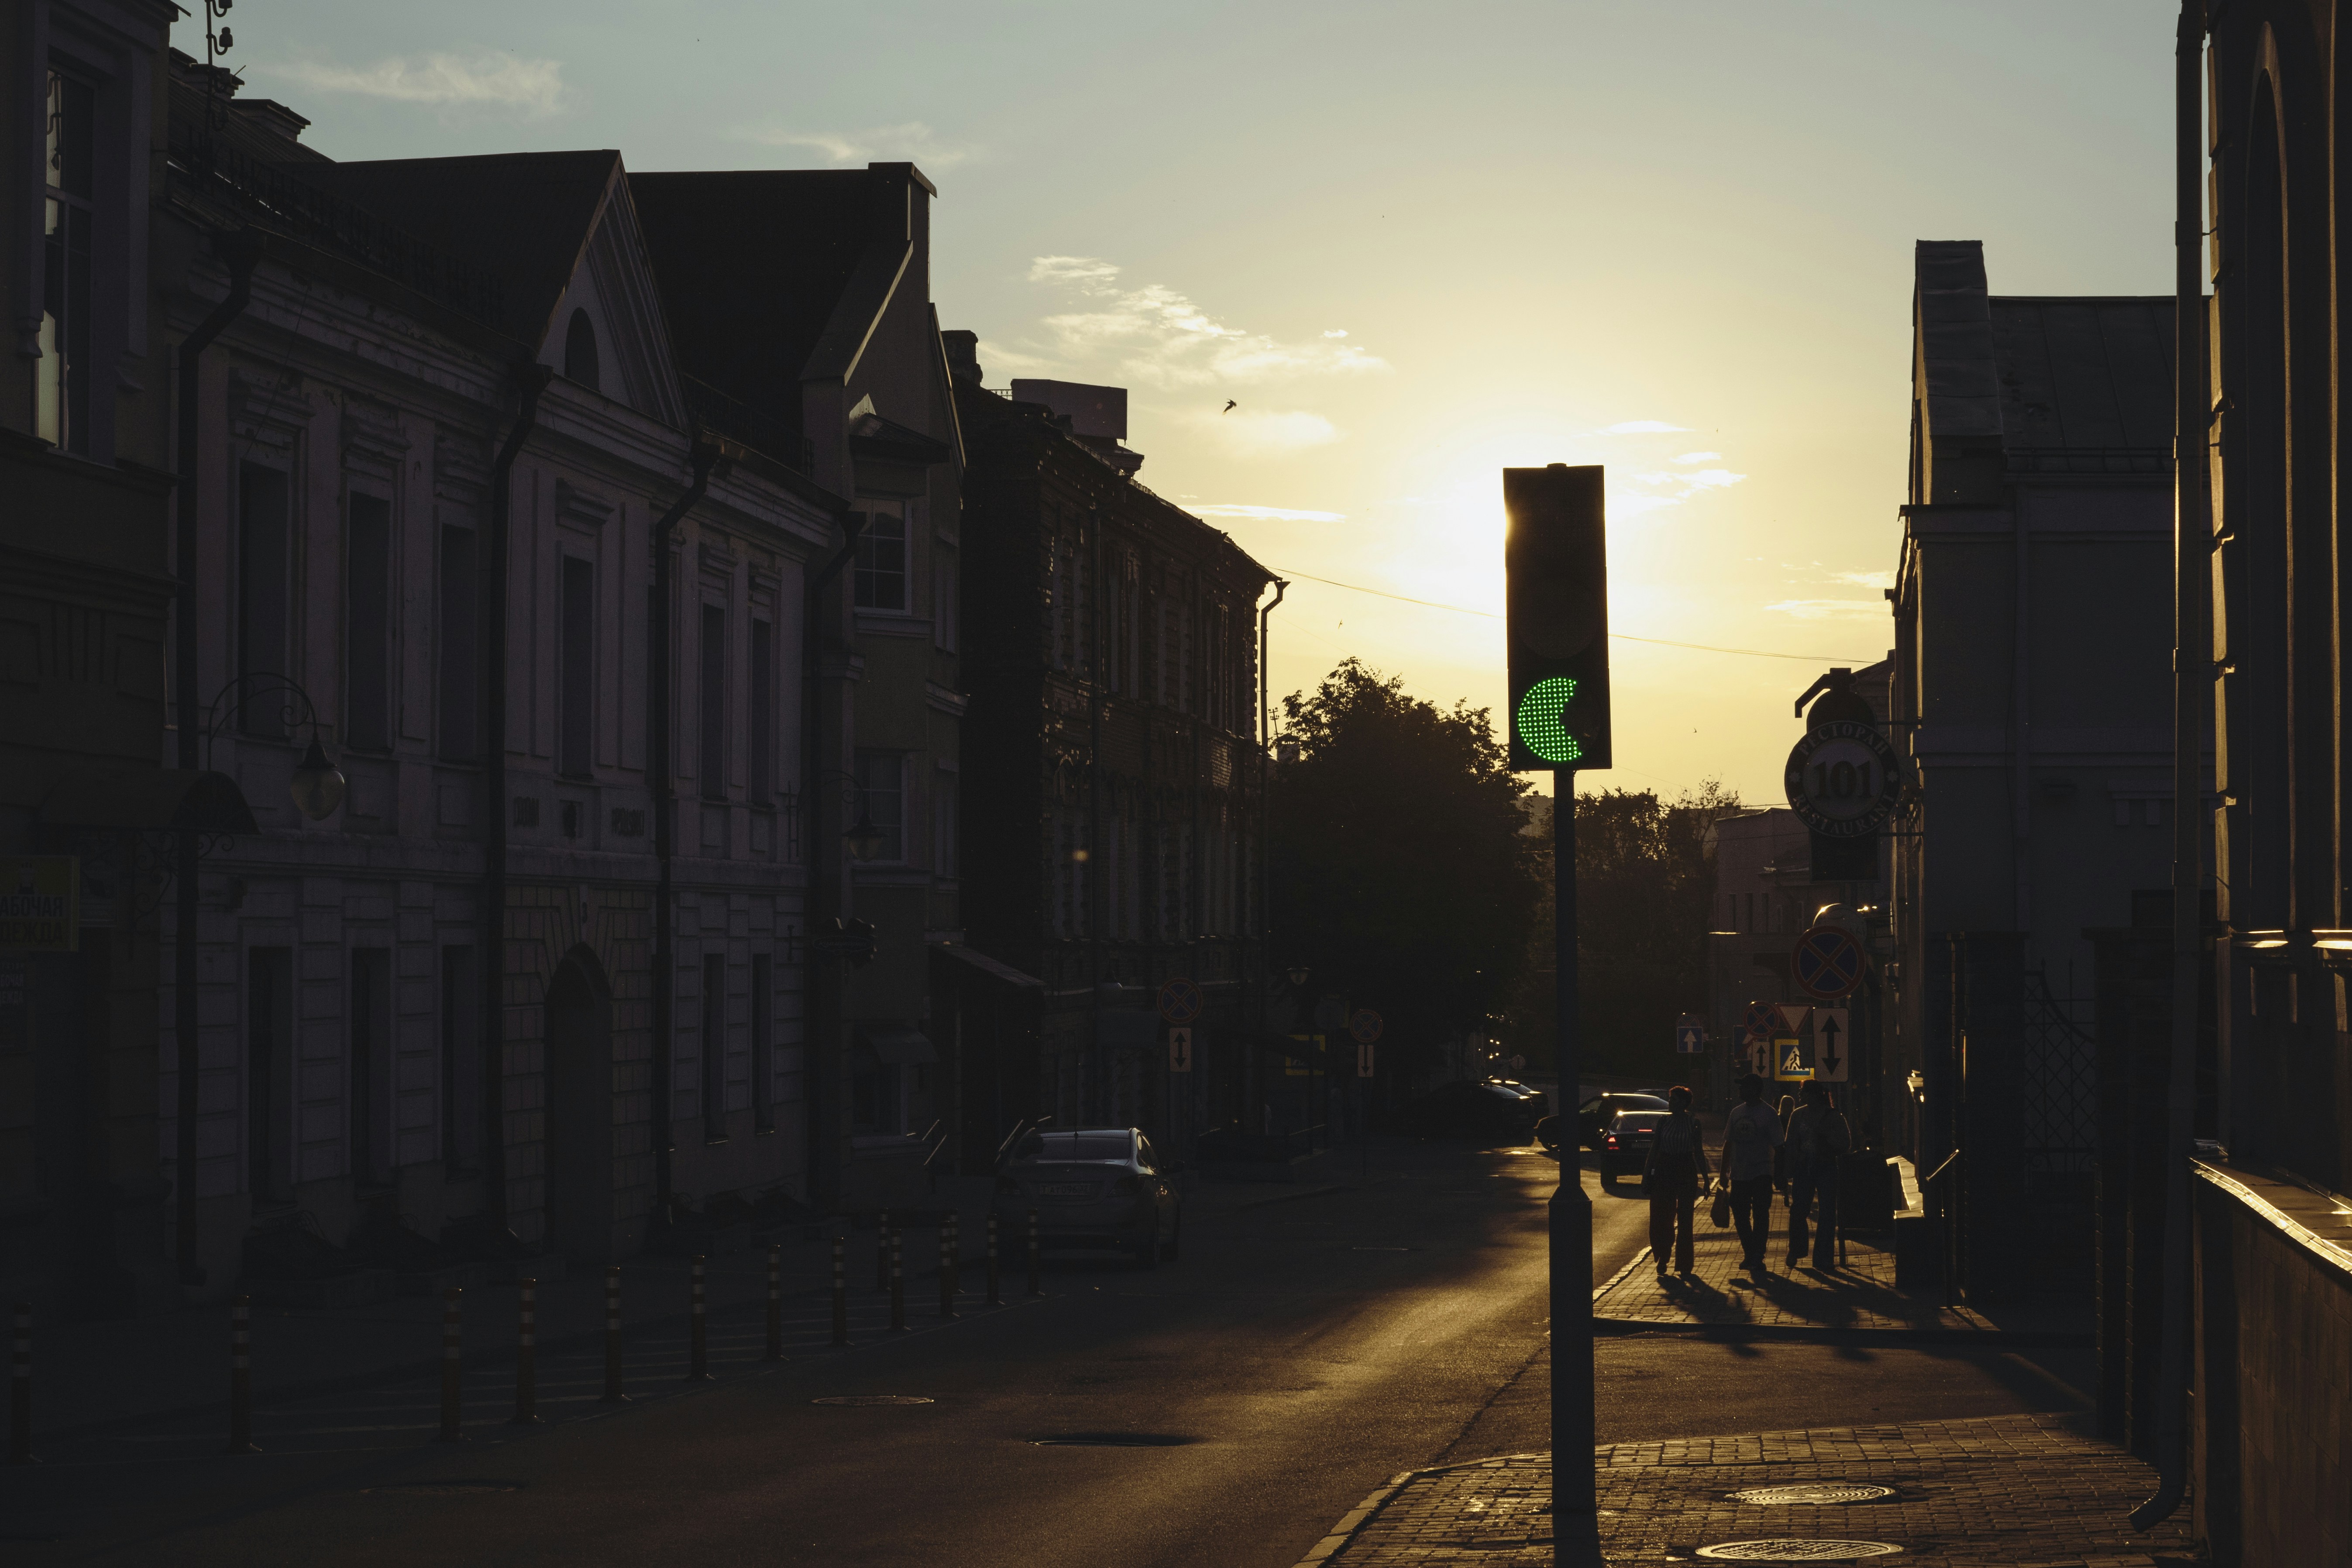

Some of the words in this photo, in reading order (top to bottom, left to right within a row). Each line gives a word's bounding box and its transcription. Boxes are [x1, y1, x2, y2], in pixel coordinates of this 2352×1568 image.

[1798, 724, 1889, 756] РЕСТОРАН
[1813, 760, 1872, 799] 101
[1792, 792, 1895, 834] RESTAURANT
[0, 896, 63, 917] АБОЧАЯ
[0, 922, 63, 945] ДЕЖДА
[0, 974, 24, 987] БОЧАЯ
[0, 990, 24, 1006] ЕЖДА
